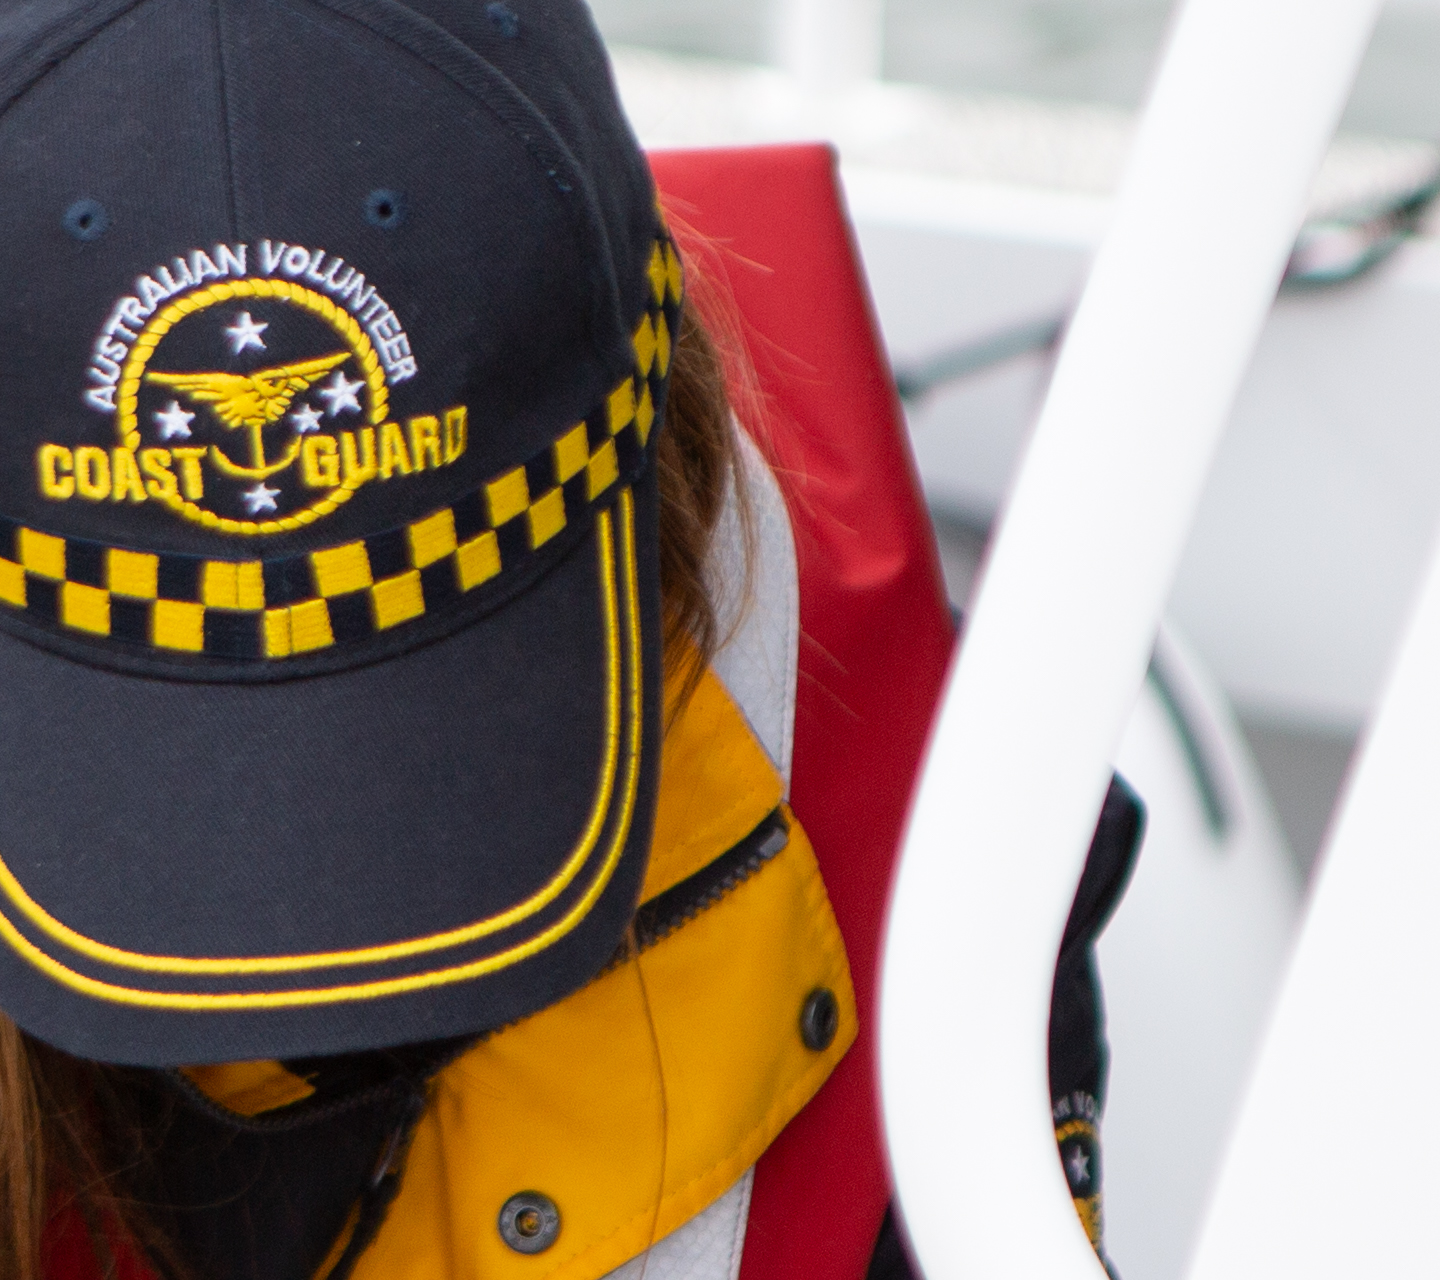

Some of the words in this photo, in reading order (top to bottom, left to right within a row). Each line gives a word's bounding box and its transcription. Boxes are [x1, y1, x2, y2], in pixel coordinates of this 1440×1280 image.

[84, 242, 249, 412] AUSTRALIAN
[259, 238, 419, 385] VOLUNTEER
[36, 442, 208, 503] COAST
[299, 404, 469, 489] GUARD
